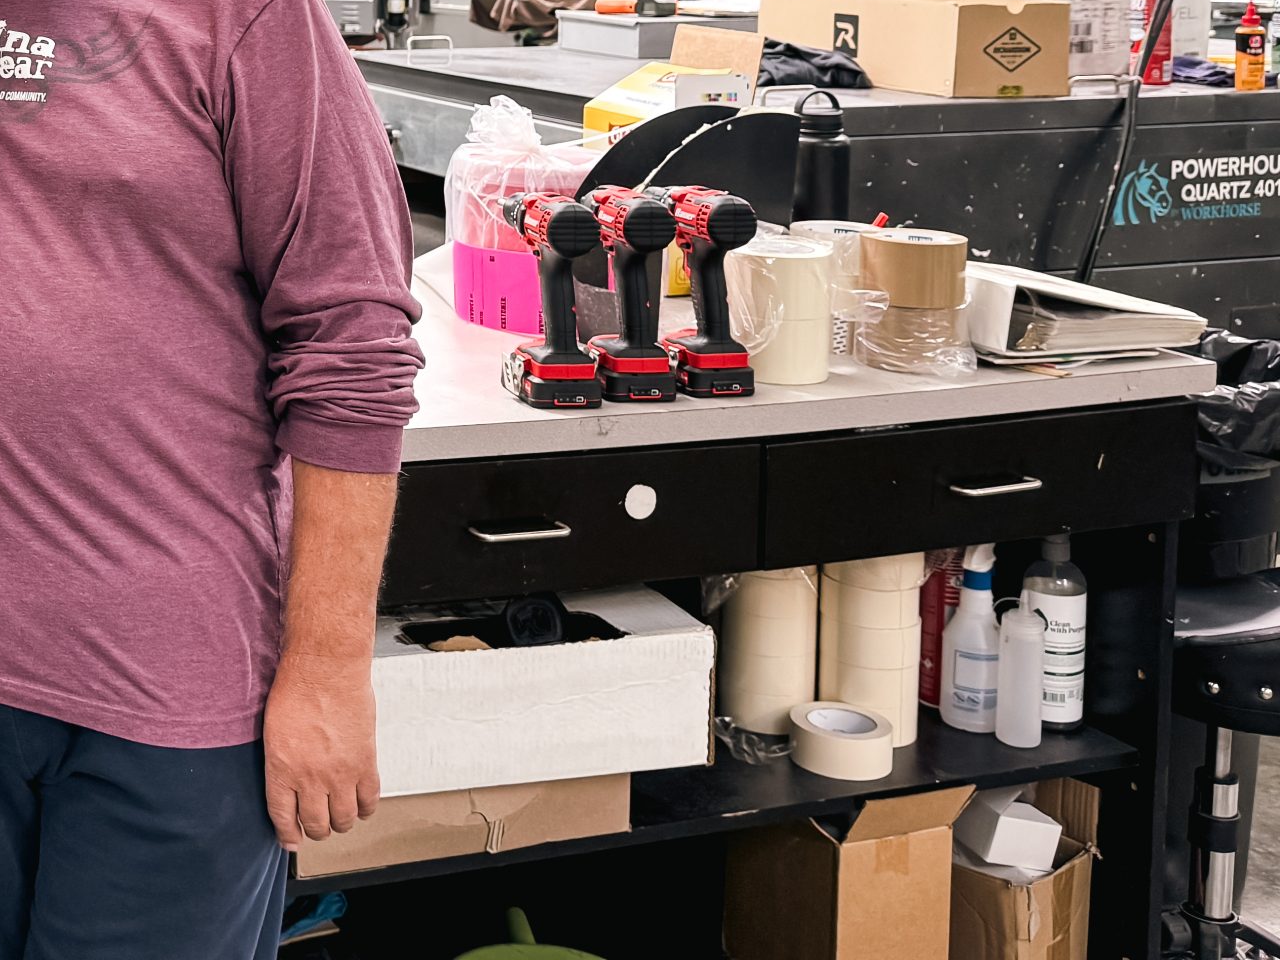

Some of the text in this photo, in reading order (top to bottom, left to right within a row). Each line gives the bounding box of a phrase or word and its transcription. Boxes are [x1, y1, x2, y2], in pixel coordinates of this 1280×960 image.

[835, 21, 856, 49] R
[5, 90, 47, 103] COMMUNITY.
[1170, 154, 1280, 180] POWERHOU
[1180, 180, 1252, 202] QUARTZ
[1180, 202, 1262, 221] WORKHORSE
